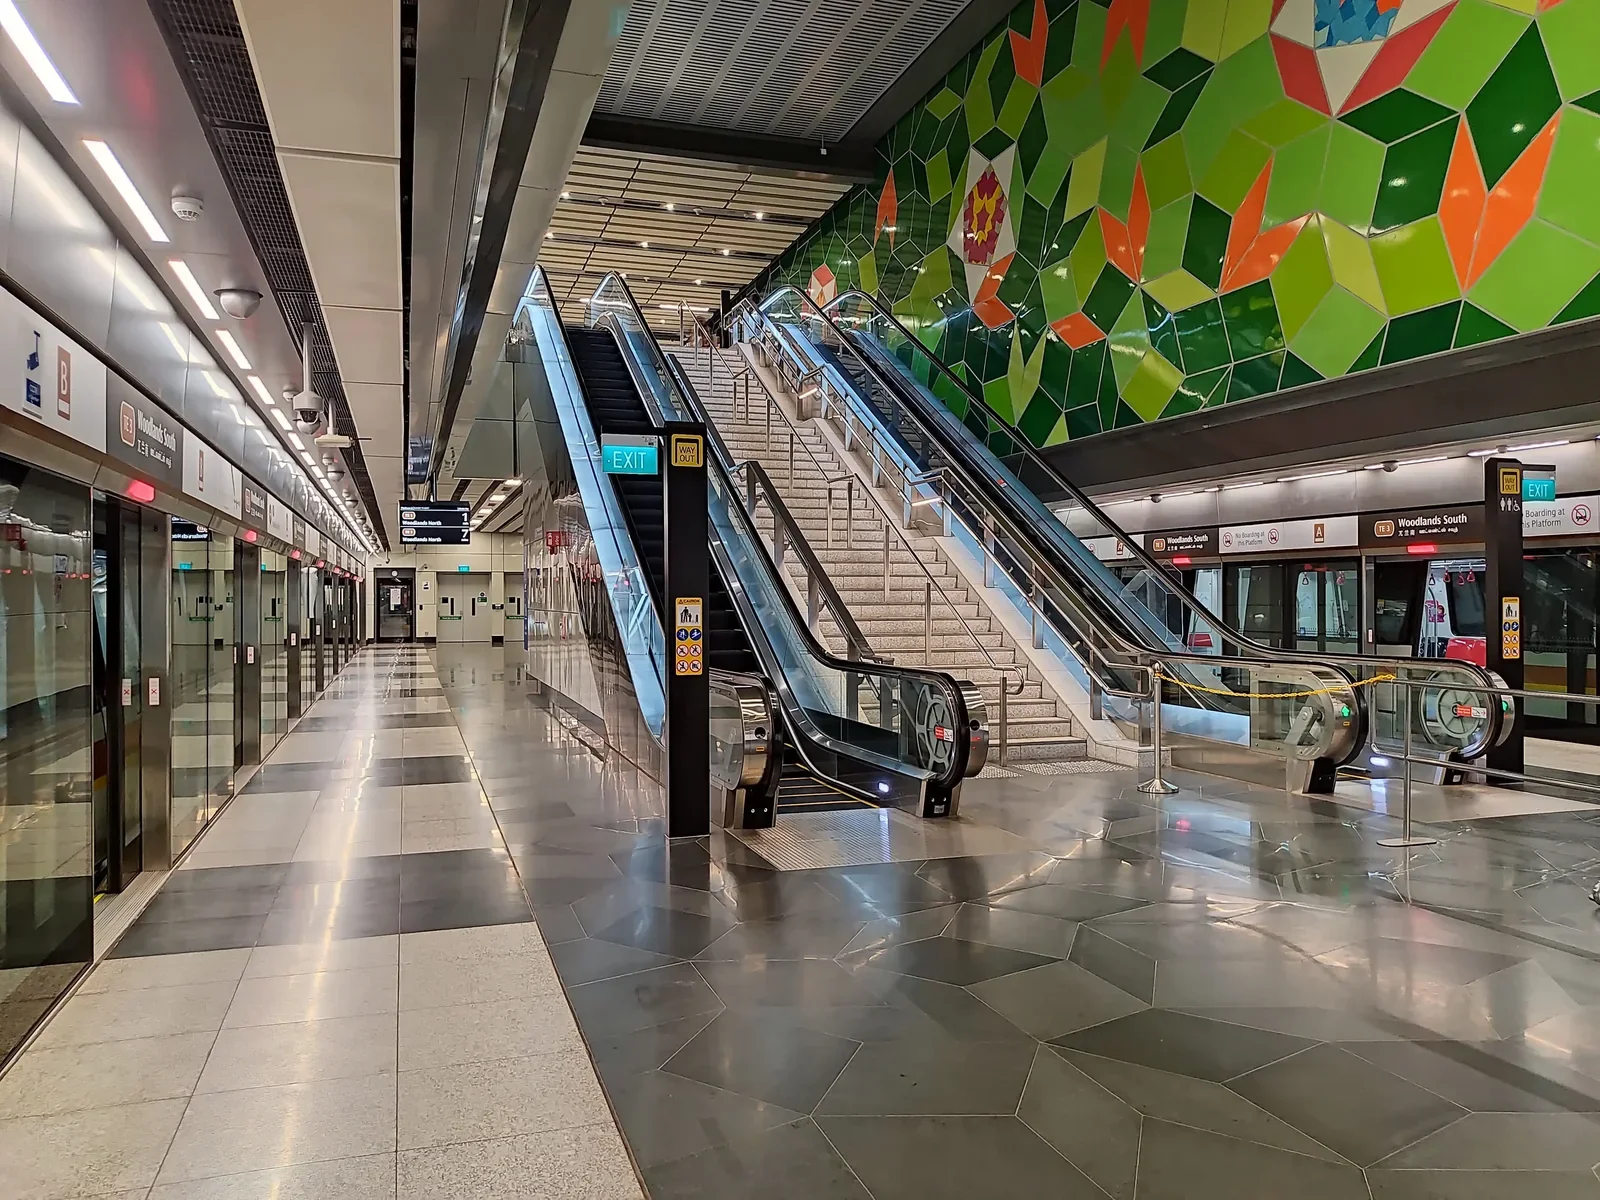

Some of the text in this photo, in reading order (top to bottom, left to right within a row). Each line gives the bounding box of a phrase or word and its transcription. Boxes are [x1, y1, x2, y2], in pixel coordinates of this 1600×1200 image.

[61, 359, 68, 395] B
[137, 409, 176, 452] Woodlands South
[679, 445, 695, 454] WAY
[613, 451, 647, 469] EXIT
[679, 454, 695, 462] OUT
[1528, 483, 1549, 498] EXIT
[461, 512, 469, 522] 1
[1525, 508, 1565, 518] Boarding at
[1398, 513, 1468, 528] Woodlands South
[1531, 519, 1562, 528] Platform
[461, 528, 469, 539] 7
[1316, 526, 1323, 537] A
[1378, 525, 1385, 533] TE
[1167, 533, 1209, 544] Woodlands South
[1241, 531, 1260, 539] Boarding
[1117, 542, 1124, 551] A
